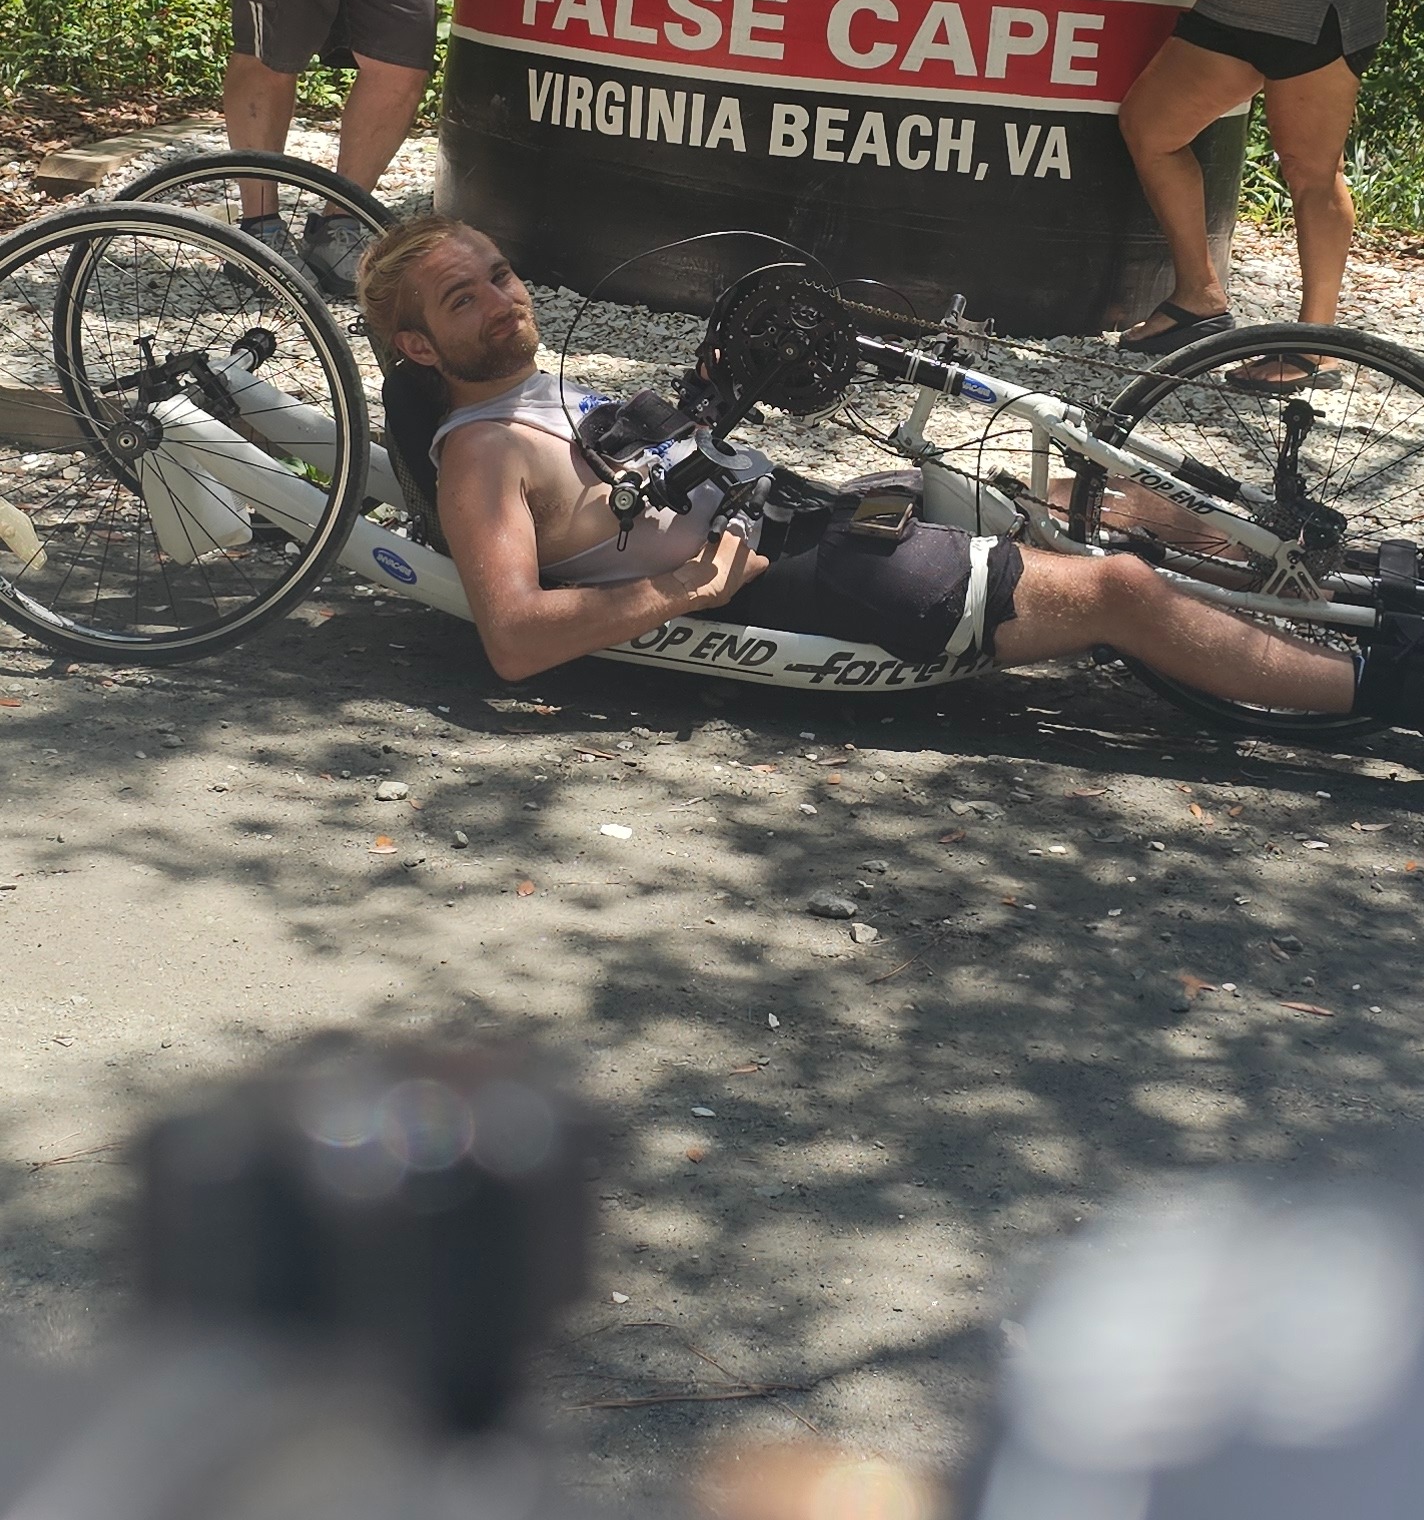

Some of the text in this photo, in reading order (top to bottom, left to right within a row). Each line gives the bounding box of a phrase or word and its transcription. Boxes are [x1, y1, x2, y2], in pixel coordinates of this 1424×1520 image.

[527, 68, 1071, 181] VIRGINIA BEACH, VA
[1130, 468, 1215, 514] TOP END
[631, 625, 777, 666] OP END
